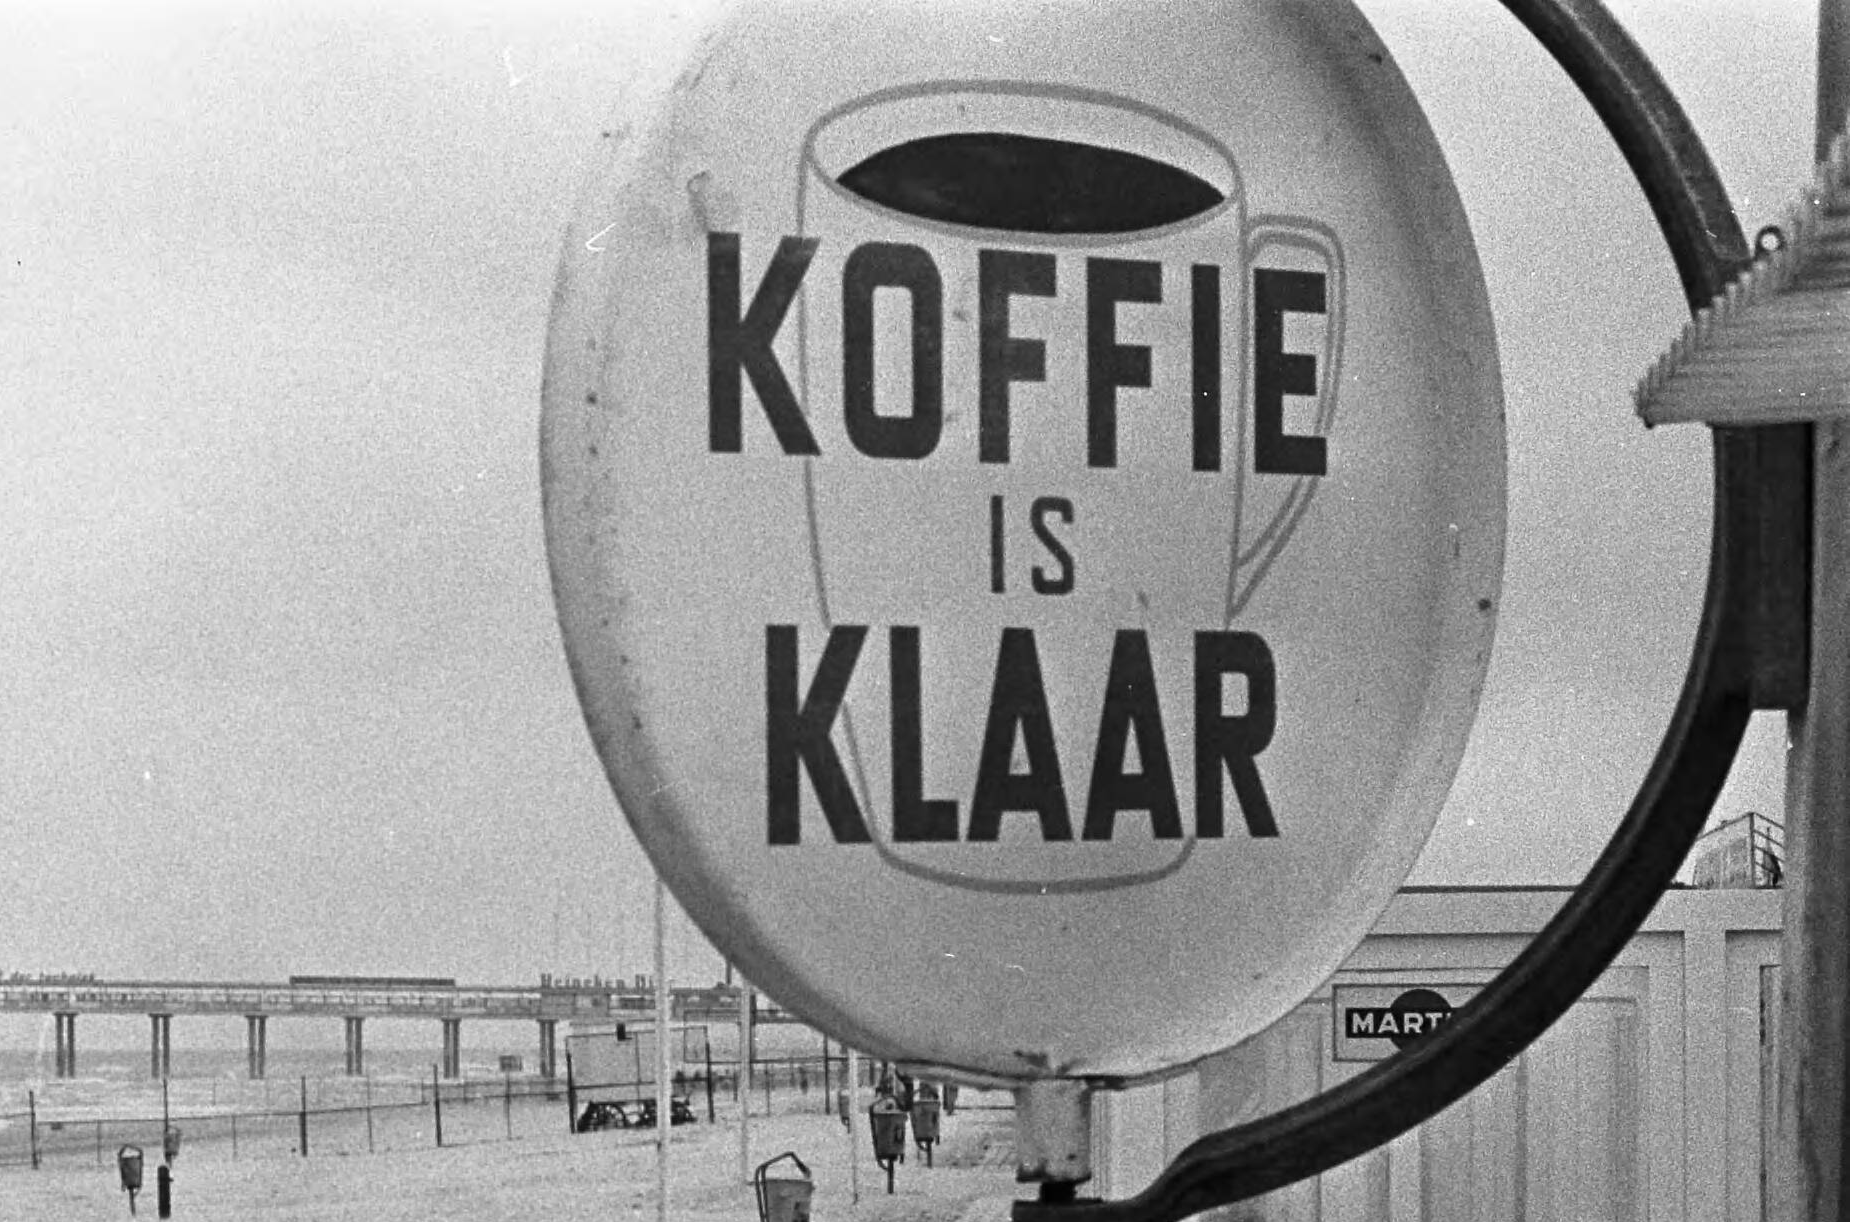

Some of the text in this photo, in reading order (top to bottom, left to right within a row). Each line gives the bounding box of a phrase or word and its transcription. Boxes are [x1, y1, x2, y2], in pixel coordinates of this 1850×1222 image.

[707, 232, 1328, 476] KOFFIE
[989, 494, 1076, 596] IS
[765, 623, 1280, 846] KLAAR
[1352, 1012, 1452, 1034] MART
